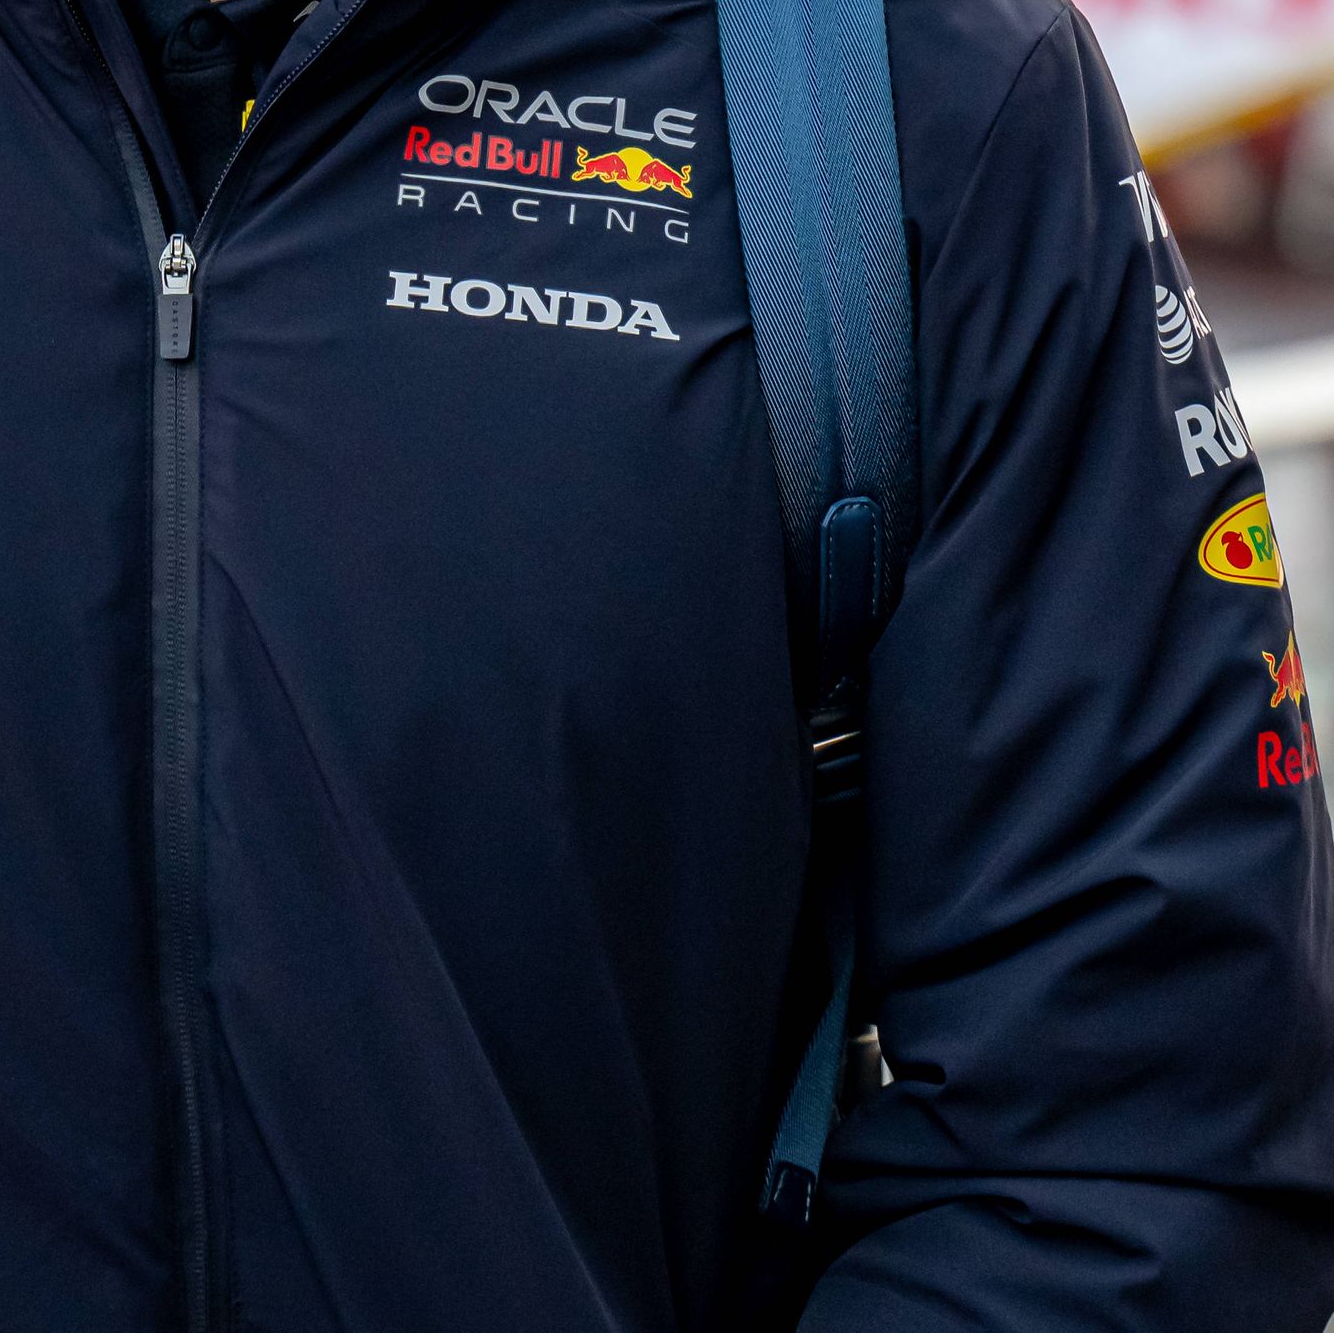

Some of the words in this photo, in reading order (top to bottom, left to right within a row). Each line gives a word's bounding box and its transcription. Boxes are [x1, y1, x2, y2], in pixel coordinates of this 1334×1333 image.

[418, 74, 699, 149] ORACLE
[403, 125, 482, 169] Red
[485, 135, 565, 179] Bull
[396, 183, 690, 244] RACING
[386, 271, 681, 341] HONDA
